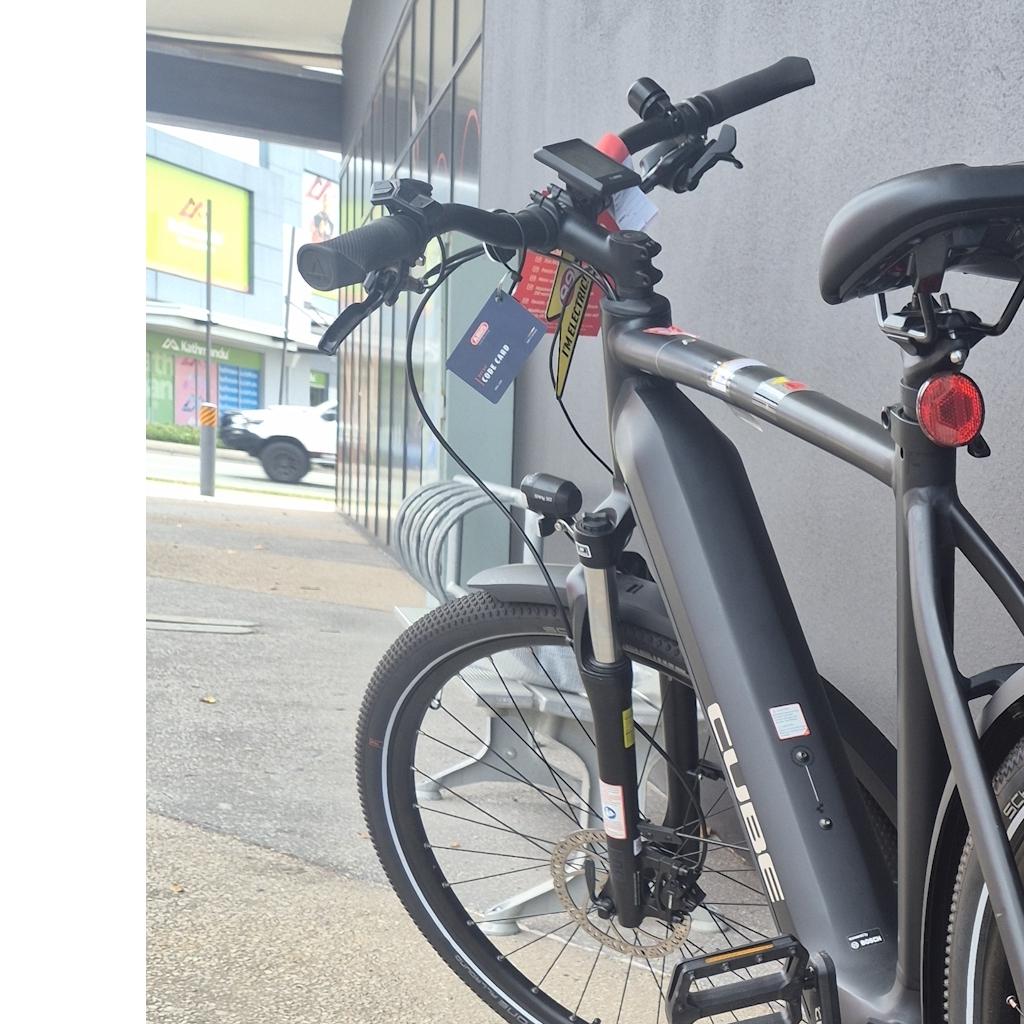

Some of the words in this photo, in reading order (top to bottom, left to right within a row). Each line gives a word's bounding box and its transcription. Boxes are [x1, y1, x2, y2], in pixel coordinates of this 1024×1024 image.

[561, 339, 572, 358] I'M
[570, 275, 590, 339] ELECTRIC!
[481, 363, 497, 383] CODE
[494, 344, 510, 364] CARD
[707, 702, 784, 902] CUBE
